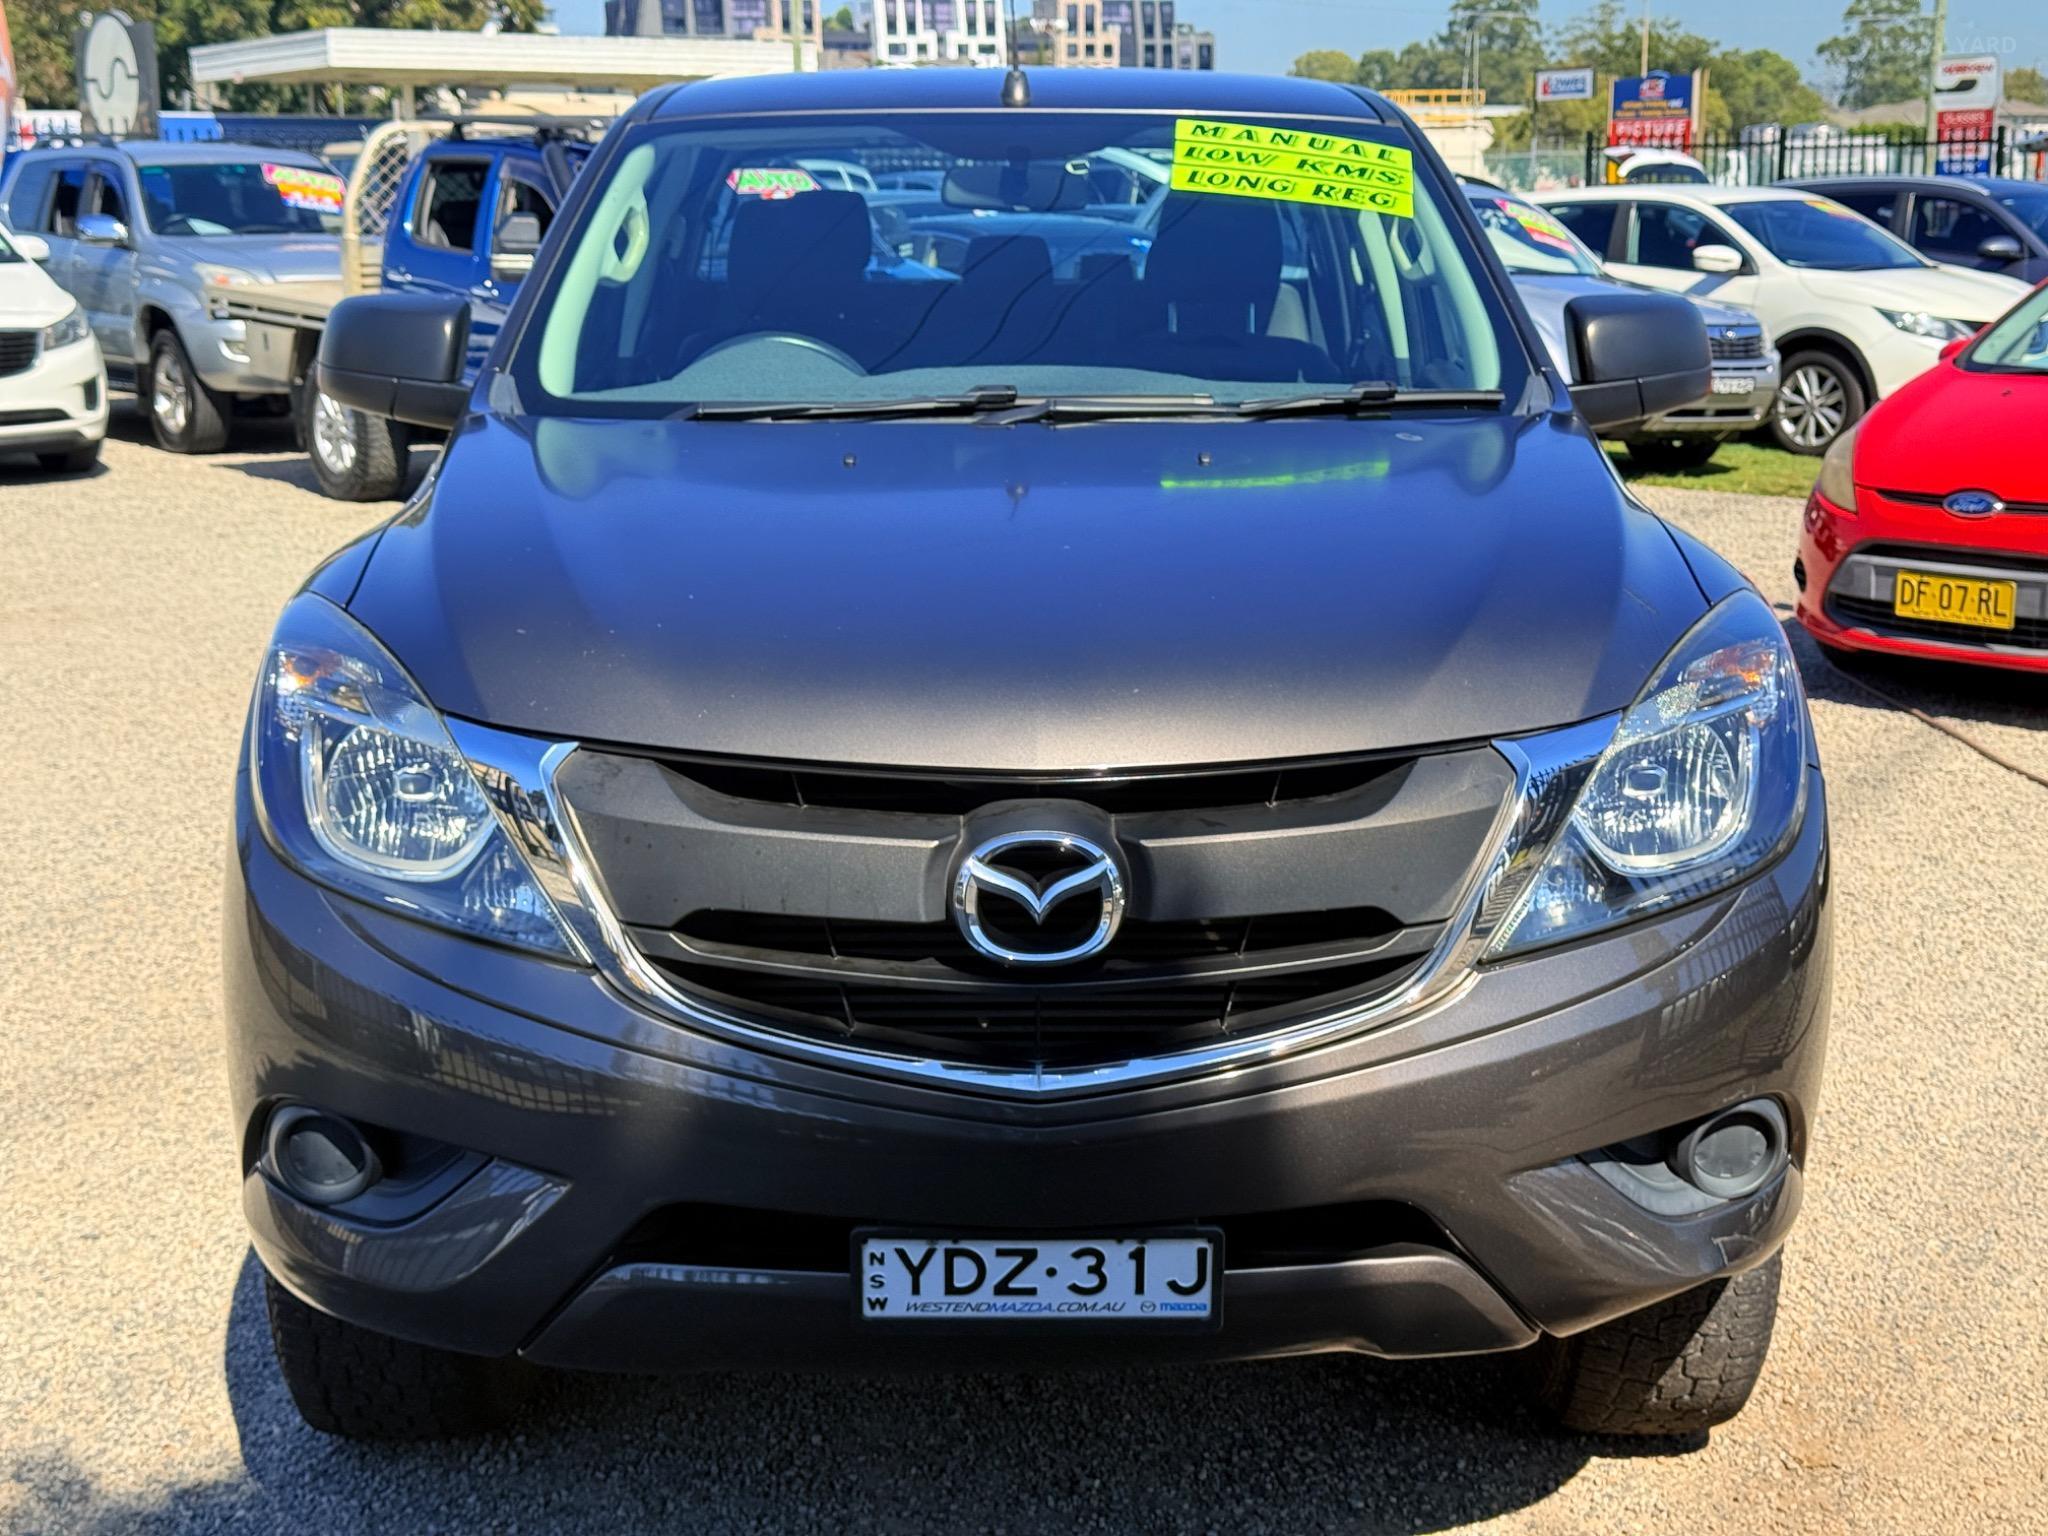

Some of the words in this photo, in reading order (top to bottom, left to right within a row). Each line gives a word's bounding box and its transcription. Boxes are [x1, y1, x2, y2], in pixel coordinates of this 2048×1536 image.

[1191, 124, 1397, 164] MANUAL
[1184, 146, 1279, 167] LOW
[1296, 159, 1404, 186] KMS
[1187, 170, 1295, 193] LONG
[1312, 183, 1397, 207] REG
[905, 1302, 1126, 1312] WESTENDMAZDA.COM.AU
[1160, 1303, 1207, 1311] mazda
